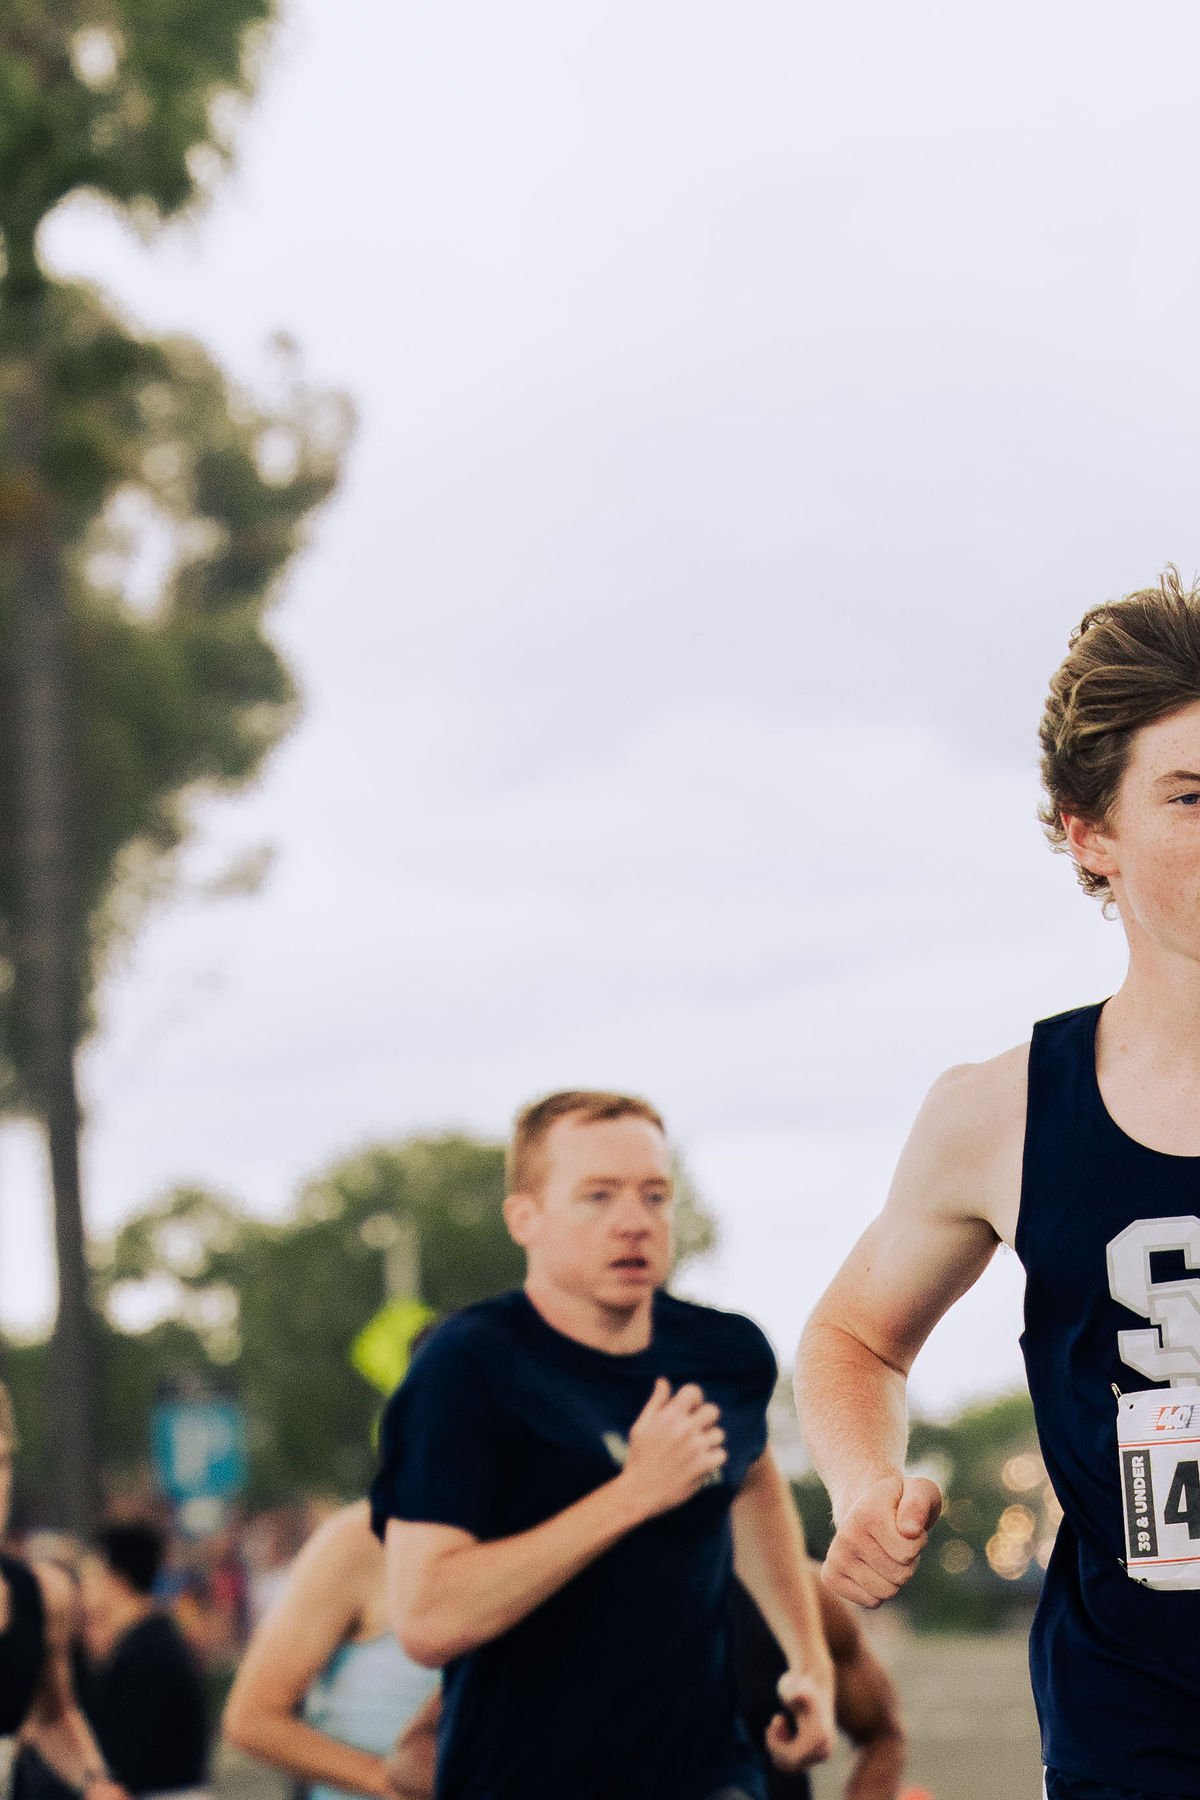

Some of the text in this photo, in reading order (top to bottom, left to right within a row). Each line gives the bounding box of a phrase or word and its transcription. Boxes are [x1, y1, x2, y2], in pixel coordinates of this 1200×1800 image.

[1131, 1455, 1151, 1552] 39 & UNDER
